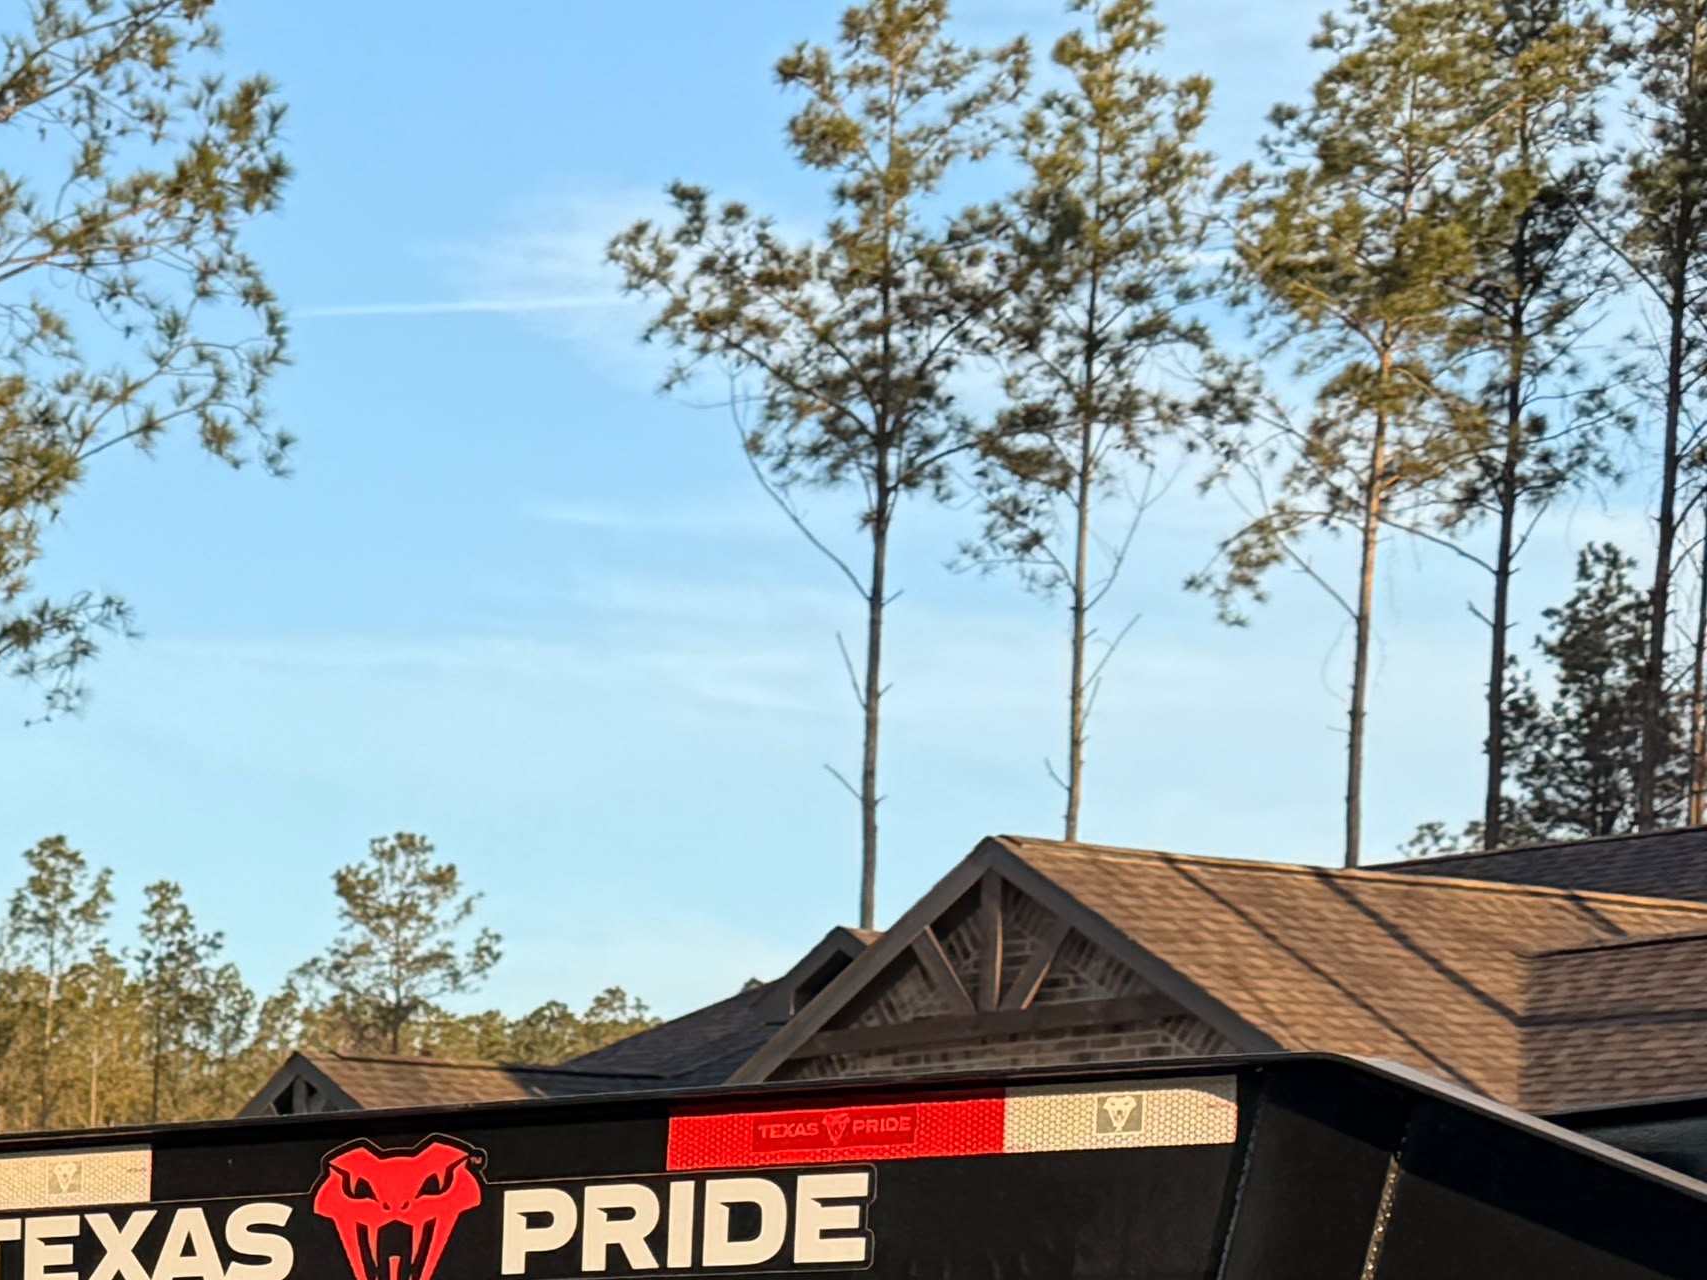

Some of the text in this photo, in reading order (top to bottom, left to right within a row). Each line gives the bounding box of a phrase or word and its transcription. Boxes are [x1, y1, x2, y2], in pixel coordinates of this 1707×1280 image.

[757, 1115, 912, 1139] TEXAS PRIDE
[500, 1171, 870, 1277] PRIDE
